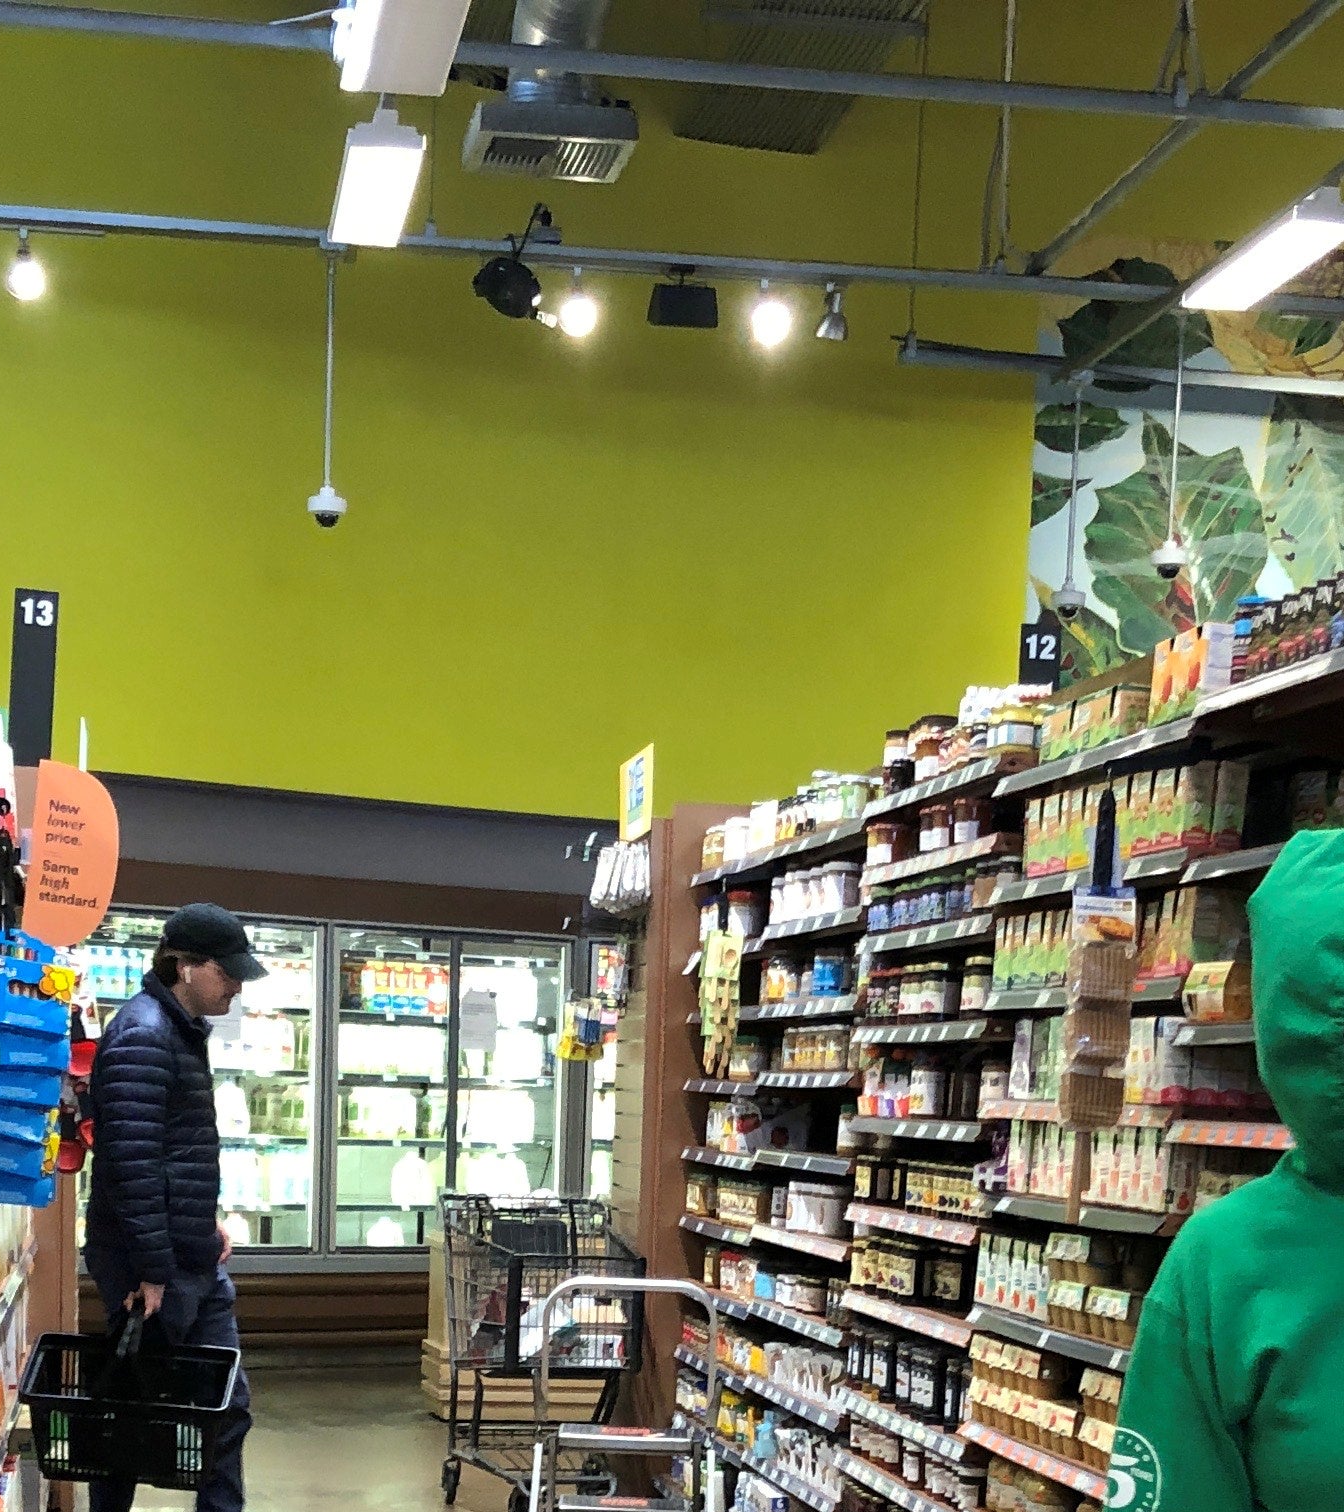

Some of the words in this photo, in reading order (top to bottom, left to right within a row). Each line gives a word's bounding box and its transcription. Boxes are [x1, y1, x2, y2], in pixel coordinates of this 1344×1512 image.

[20, 598, 54, 627] 13
[1025, 632, 1056, 660] 12
[49, 799, 80, 815] New
[47, 813, 86, 831] lower
[45, 831, 83, 847] price.
[42, 859, 79, 876] Same
[40, 873, 70, 890] high
[38, 889, 99, 910] standard.
